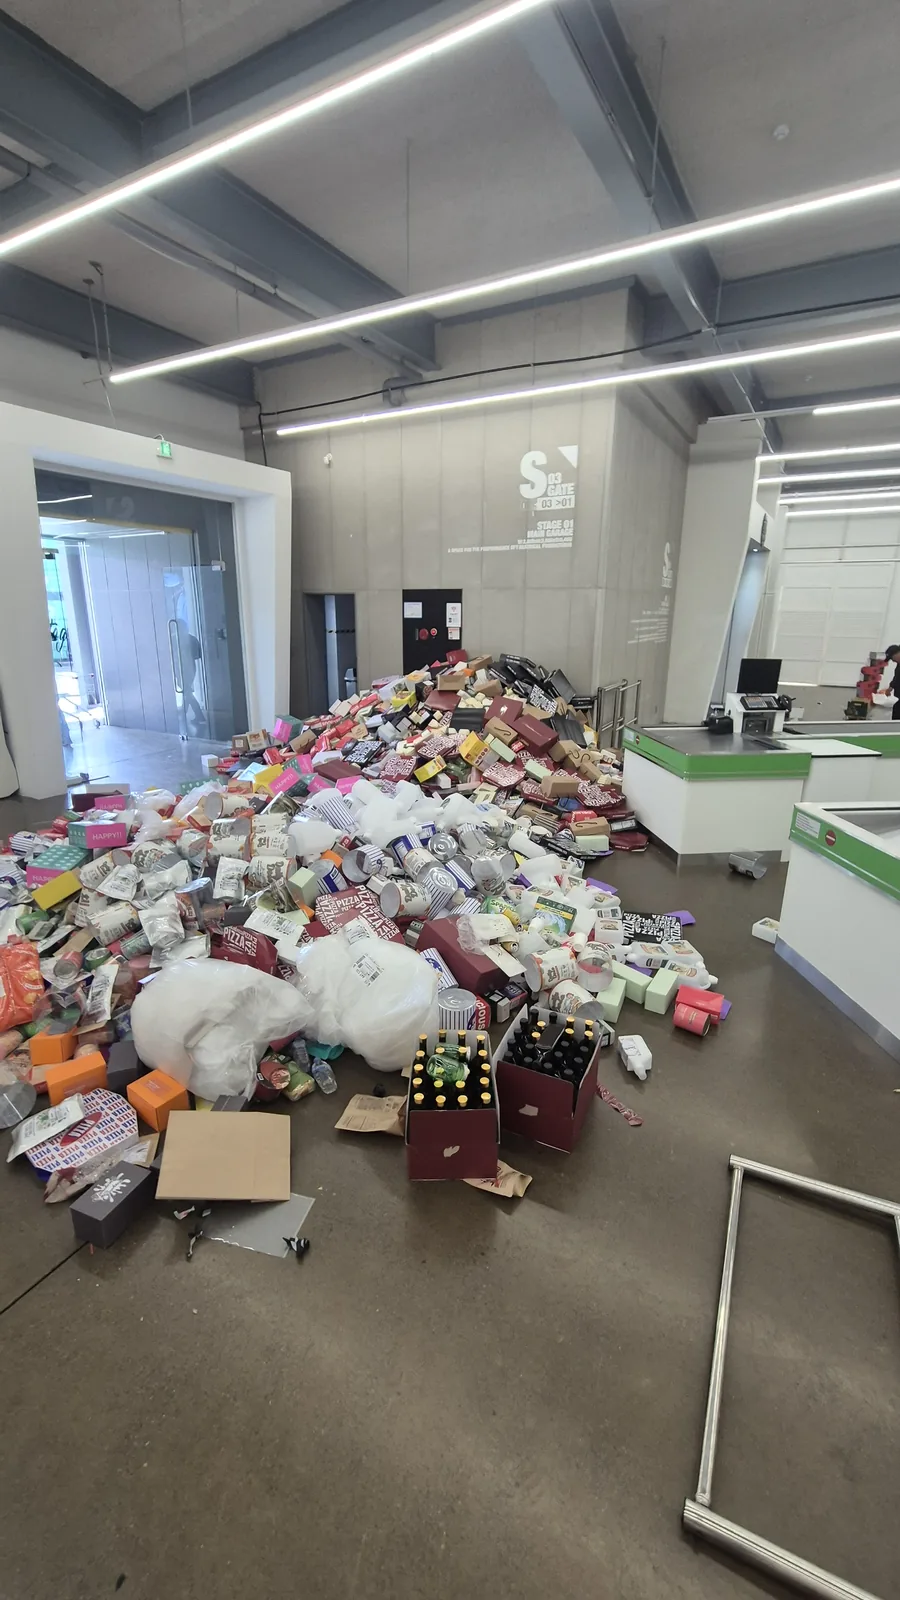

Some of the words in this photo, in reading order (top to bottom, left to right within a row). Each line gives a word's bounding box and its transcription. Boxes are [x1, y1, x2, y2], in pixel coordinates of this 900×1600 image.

[519, 450, 548, 499] S
[548, 472, 562, 484] 03
[547, 482, 575, 496] GATE
[542, 499, 552, 508] 03
[537, 520, 562, 530] STAGE
[563, 518, 574, 528] 01
[92, 832, 122, 840] HAPPY!!
[336, 896, 360, 908] PIZZA
[355, 902, 383, 928] PIZZA
[224, 926, 244, 948] PIZZA
